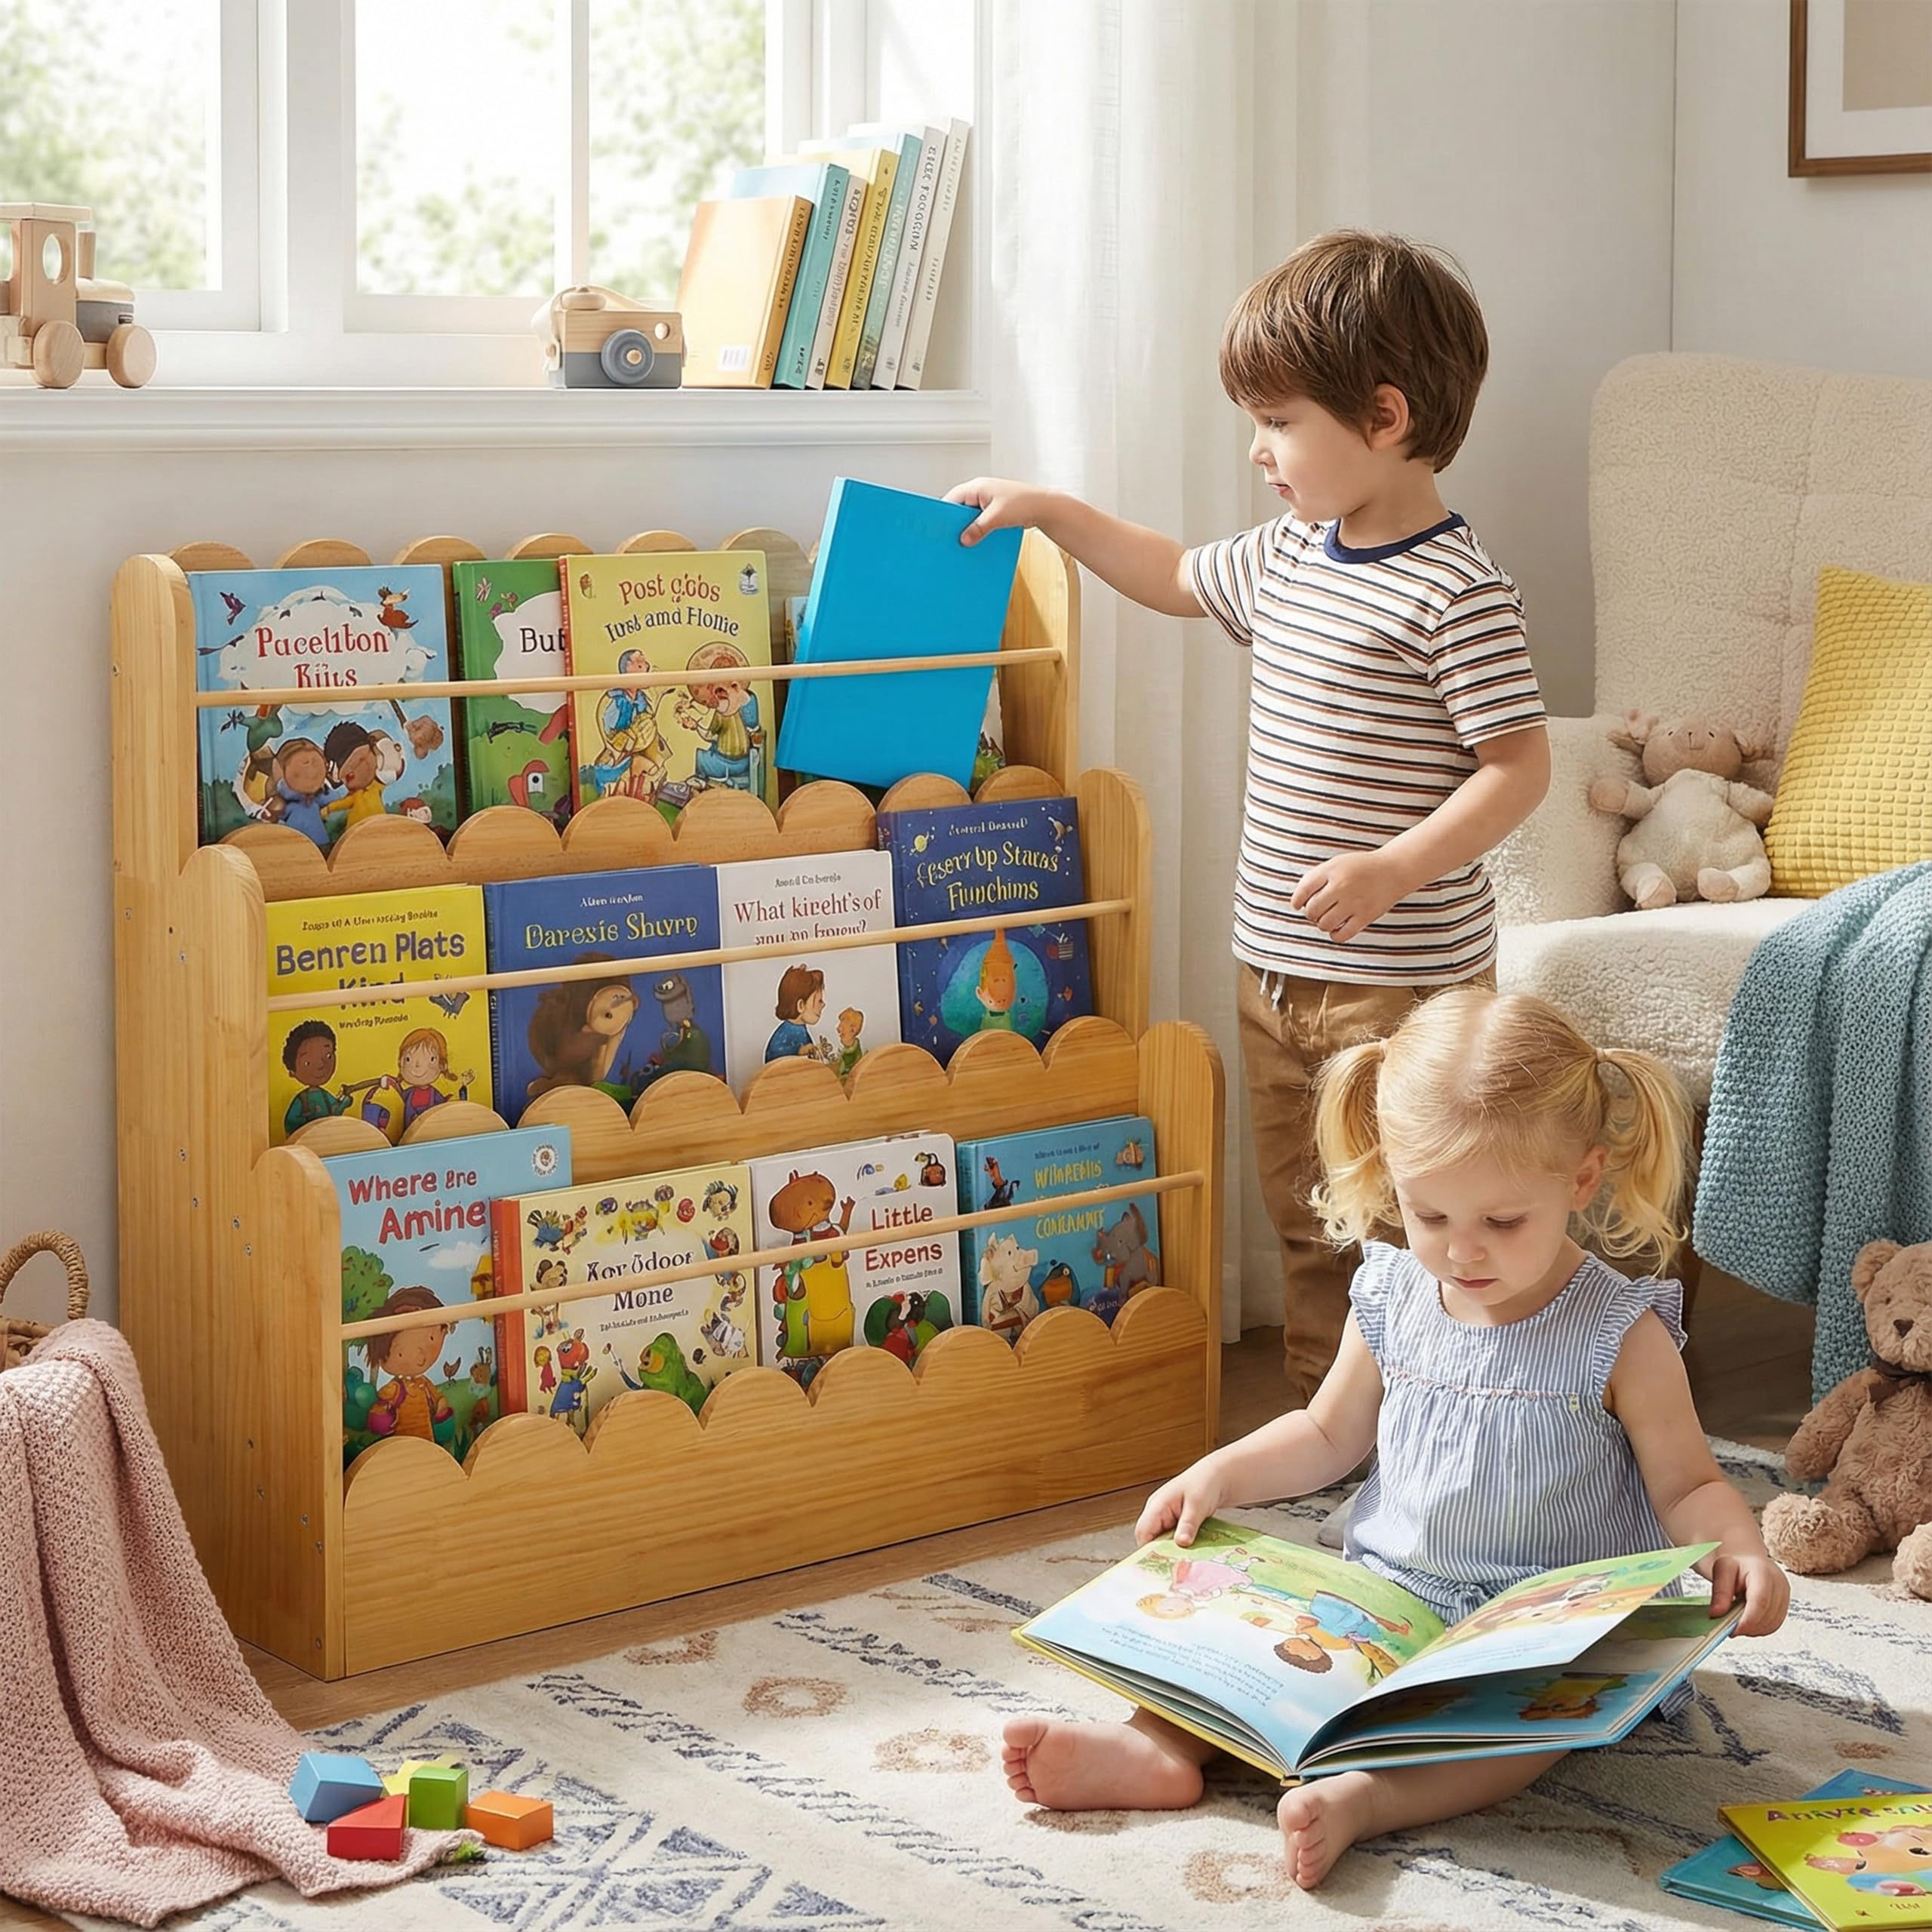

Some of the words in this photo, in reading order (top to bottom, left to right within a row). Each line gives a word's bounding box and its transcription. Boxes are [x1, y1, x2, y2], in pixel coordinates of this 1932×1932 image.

[619, 574, 666, 605] Post
[734, 900, 786, 924] What
[276, 942, 387, 976] Benren
[395, 931, 465, 962] Plats
[349, 1172, 437, 1205] Where
[379, 1199, 487, 1244] Amine
[872, 1203, 933, 1231] Little
[866, 1244, 942, 1271] Expens
[613, 1287, 673, 1312] Mone
